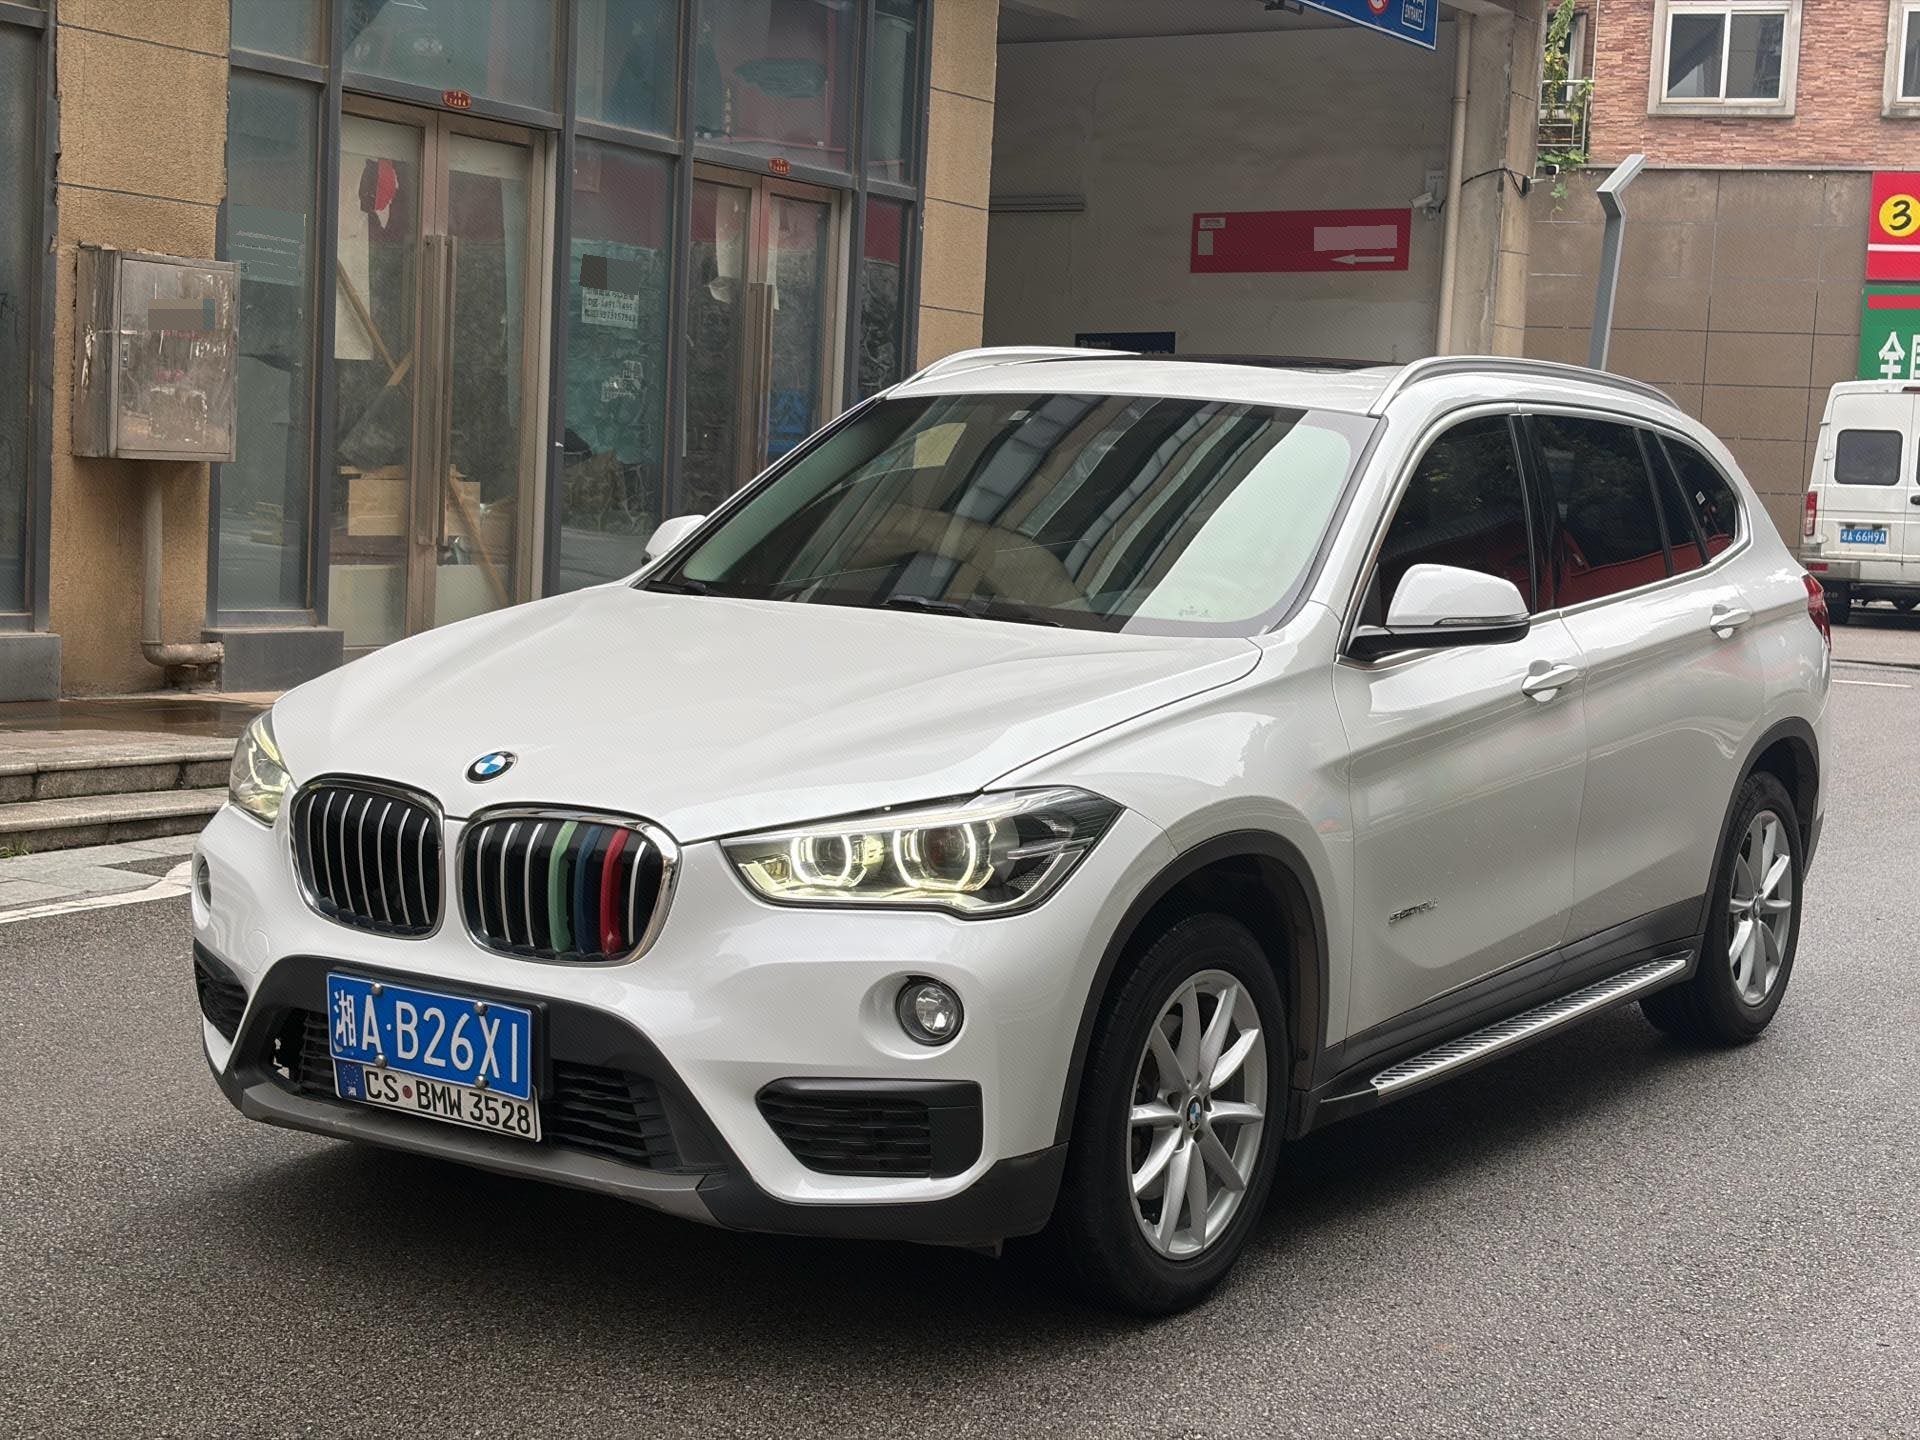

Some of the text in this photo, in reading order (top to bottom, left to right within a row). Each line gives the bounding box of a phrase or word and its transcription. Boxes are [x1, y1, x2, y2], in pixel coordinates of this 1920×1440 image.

[1889, 200, 1912, 231] 3
[365, 1070, 531, 1135] CS BMW 3528
